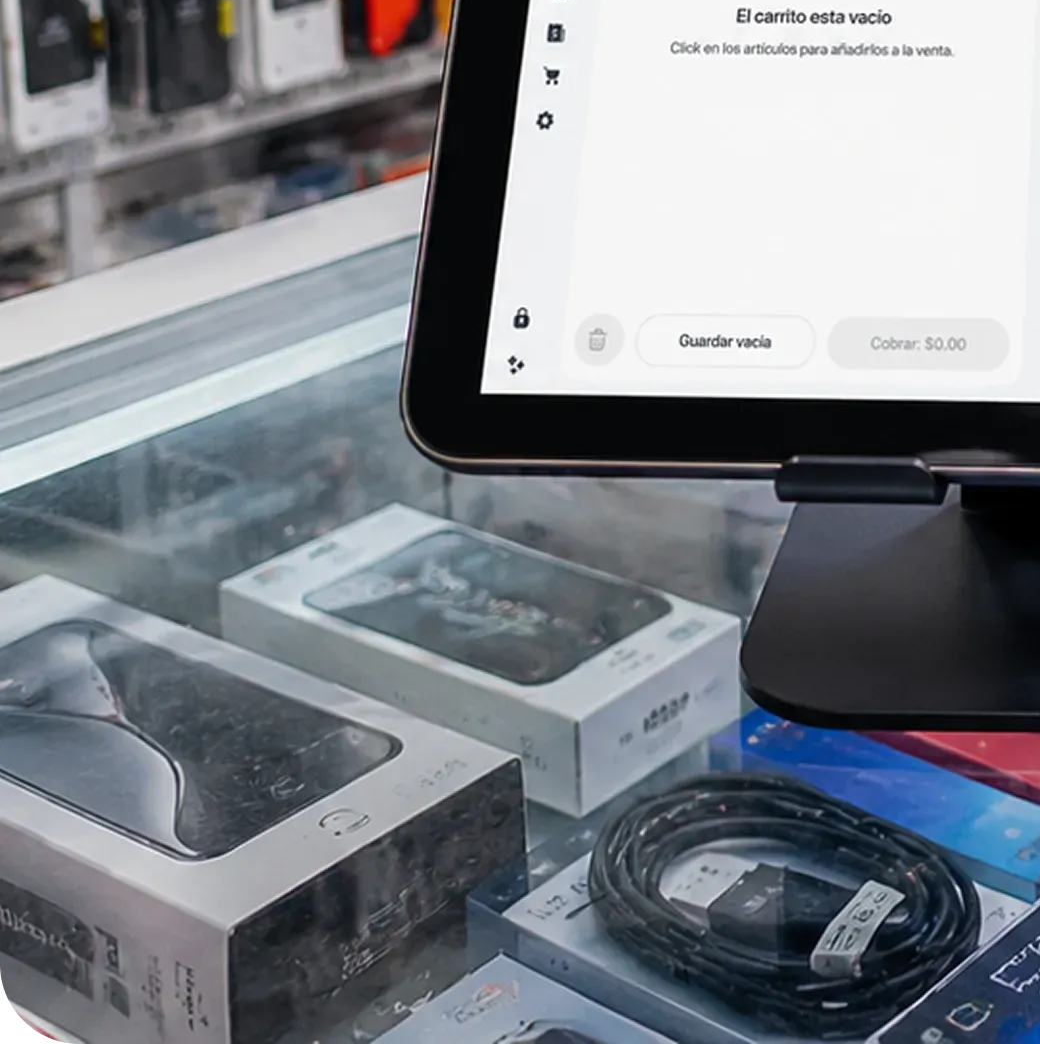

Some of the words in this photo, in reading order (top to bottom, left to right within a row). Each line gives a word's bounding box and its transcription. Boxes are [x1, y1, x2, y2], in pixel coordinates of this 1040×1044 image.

[735, 7, 752, 24] El
[754, 8, 807, 25] carrito
[669, 40, 702, 55] Click
[703, 43, 720, 55] en
[722, 42, 741, 55] los
[799, 45, 829, 59] para
[891, 45, 901, 57] a
[902, 43, 914, 57] la
[915, 45, 954, 58] venta.
[678, 333, 734, 350] Guardar
[869, 335, 921, 351] Cobrar:
[924, 336, 968, 352] $0.00
